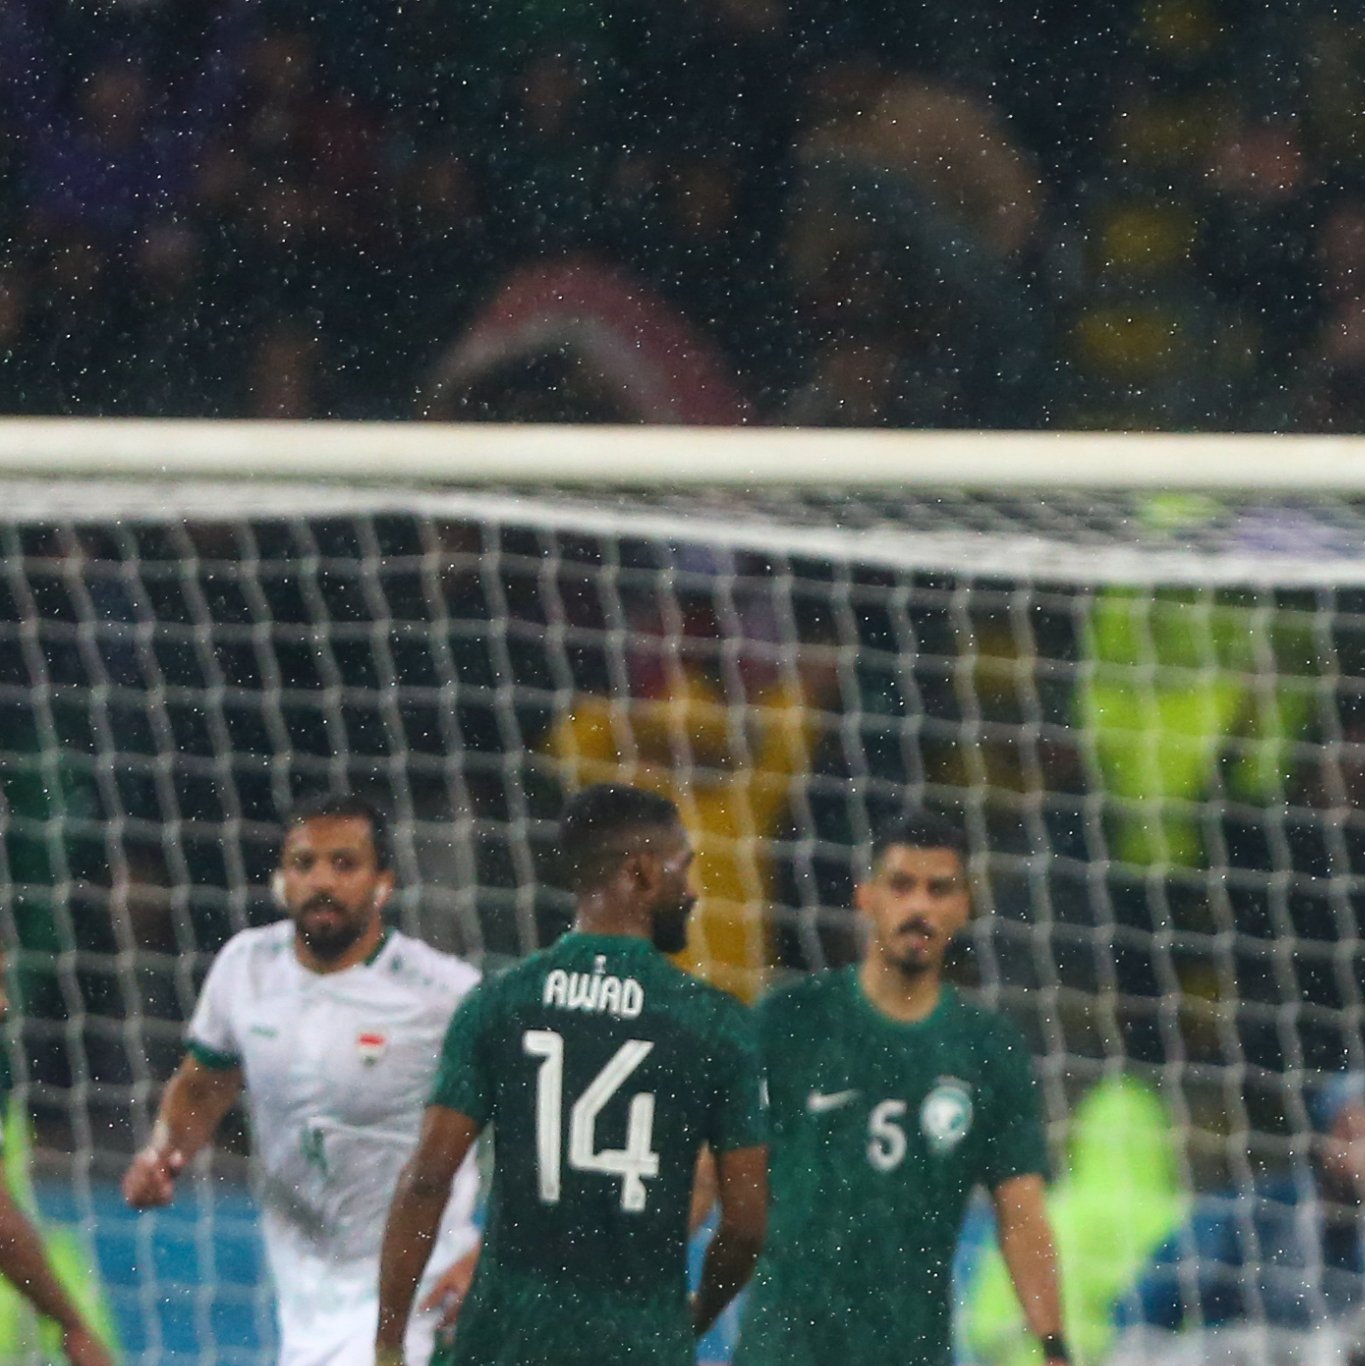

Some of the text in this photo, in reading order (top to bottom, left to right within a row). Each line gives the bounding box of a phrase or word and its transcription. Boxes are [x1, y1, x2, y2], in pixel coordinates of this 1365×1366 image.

[543, 968, 645, 1020] AWAD
[523, 1029, 659, 1211] 14
[868, 1099, 907, 1171] 5
